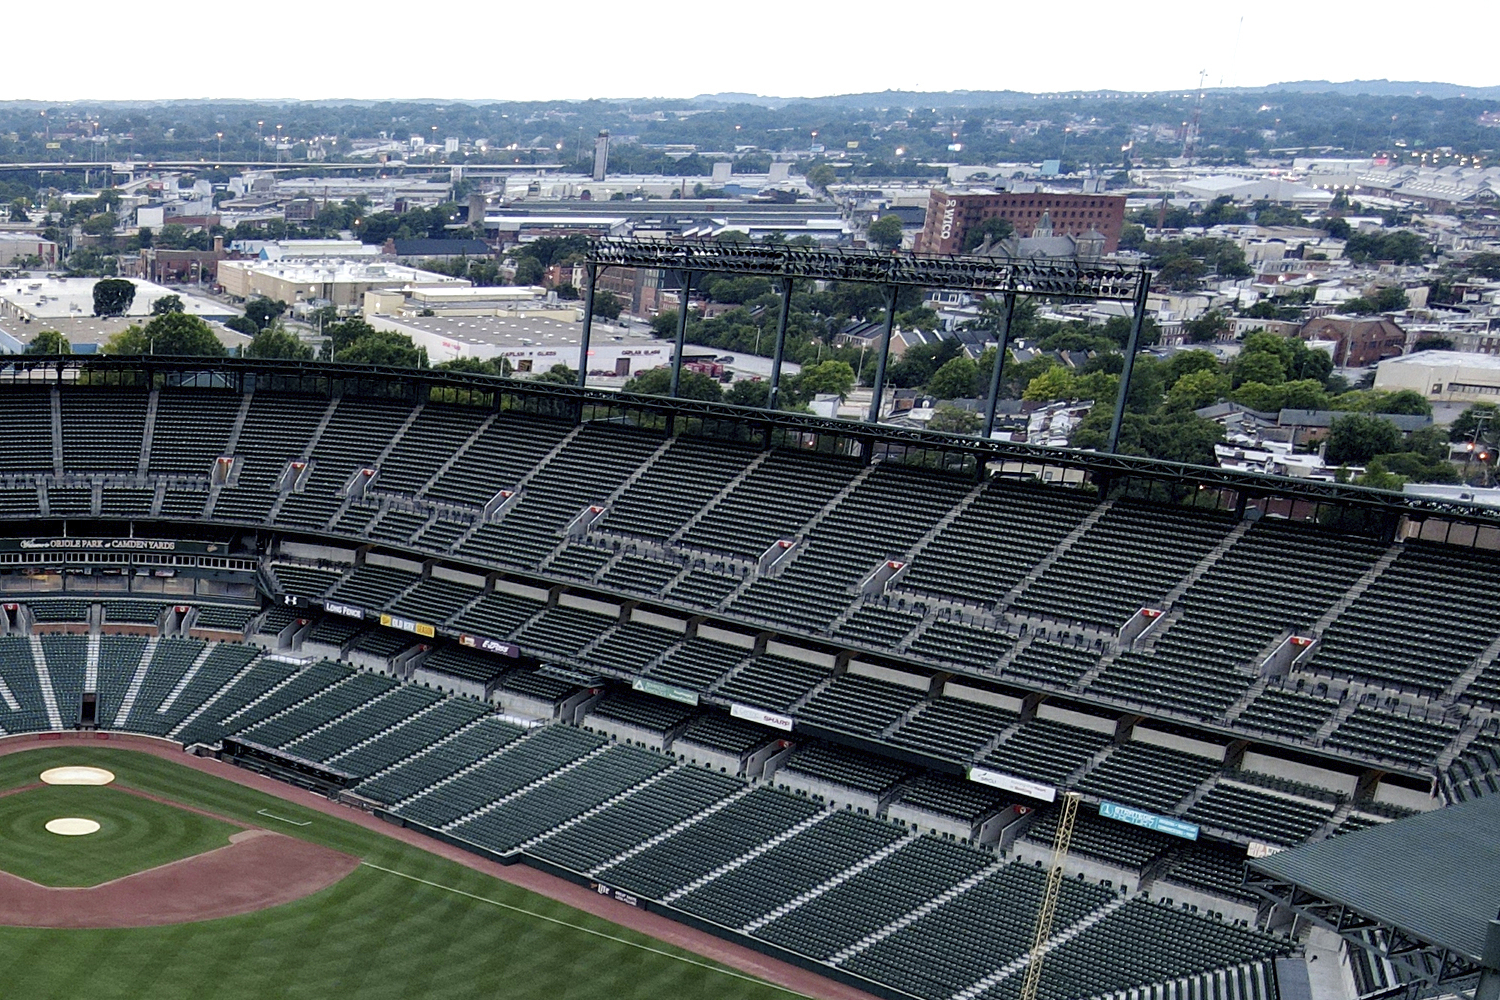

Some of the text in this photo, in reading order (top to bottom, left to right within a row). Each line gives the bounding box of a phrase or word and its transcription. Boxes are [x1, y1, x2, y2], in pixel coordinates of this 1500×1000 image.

[50, 540, 81, 548] ORIOLE
[112, 540, 147, 549] CAMDEN
[148, 541, 175, 550] YARDS
